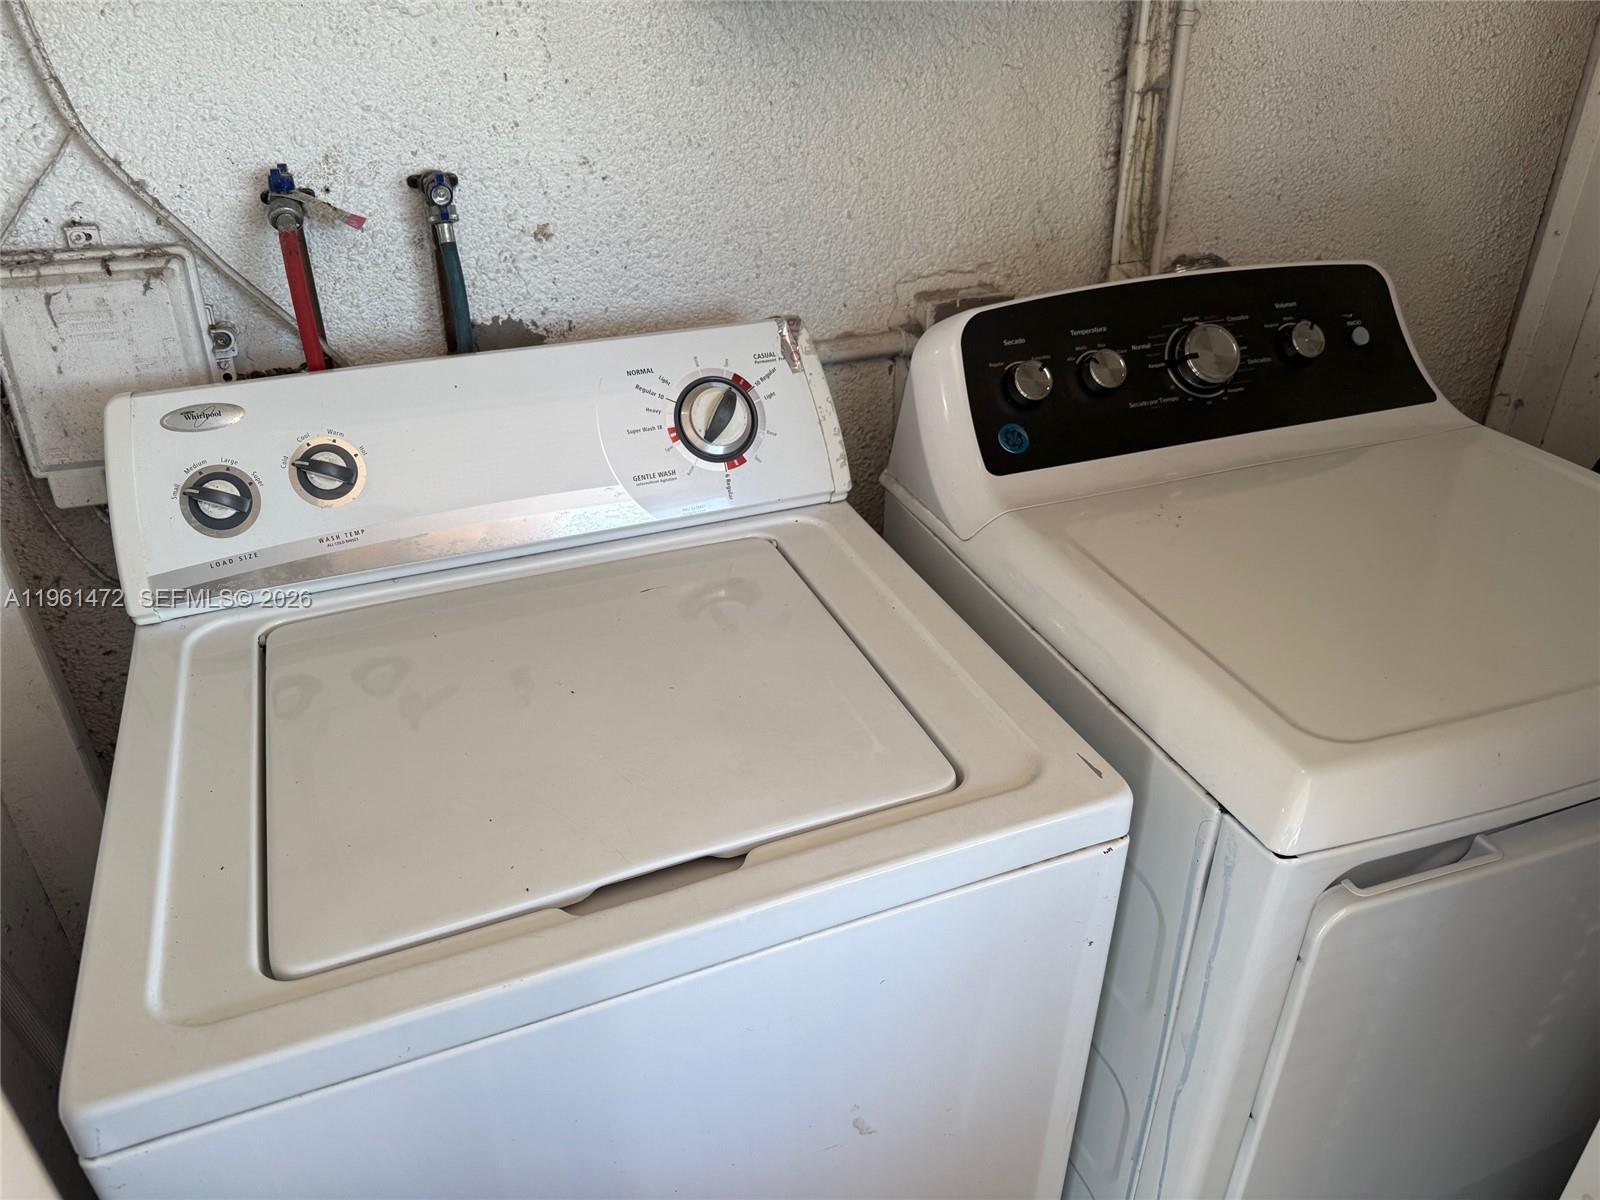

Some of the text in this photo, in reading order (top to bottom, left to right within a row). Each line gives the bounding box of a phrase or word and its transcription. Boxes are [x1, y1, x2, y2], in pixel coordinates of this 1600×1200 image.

[1070, 326, 1107, 337] Temperatura
[1003, 338, 1026, 347] Secado
[753, 351, 776, 360] CASUAL
[626, 367, 654, 376] NORMAL
[760, 367, 777, 381] Regular
[658, 375, 671, 386] Light
[635, 384, 657, 397] Regular
[764, 391, 776, 400] Light
[183, 410, 222, 422] Whirlpool
[646, 407, 662, 415] Heavy
[327, 428, 345, 438] Warm
[642, 425, 656, 433] Wash
[296, 432, 310, 443] Cool
[359, 445, 368, 456] Hot
[183, 459, 207, 475] Medium
[220, 457, 239, 466] Large
[280, 455, 289, 469] Cold
[250, 471, 264, 487] Super
[633, 471, 656, 482] GENTLE
[657, 469, 677, 478] WASH
[171, 483, 180, 500] Small
[725, 478, 734, 500] Regular
[318, 528, 365, 544] WASH TEMP
[209, 552, 259, 569] LOAD SIZE
